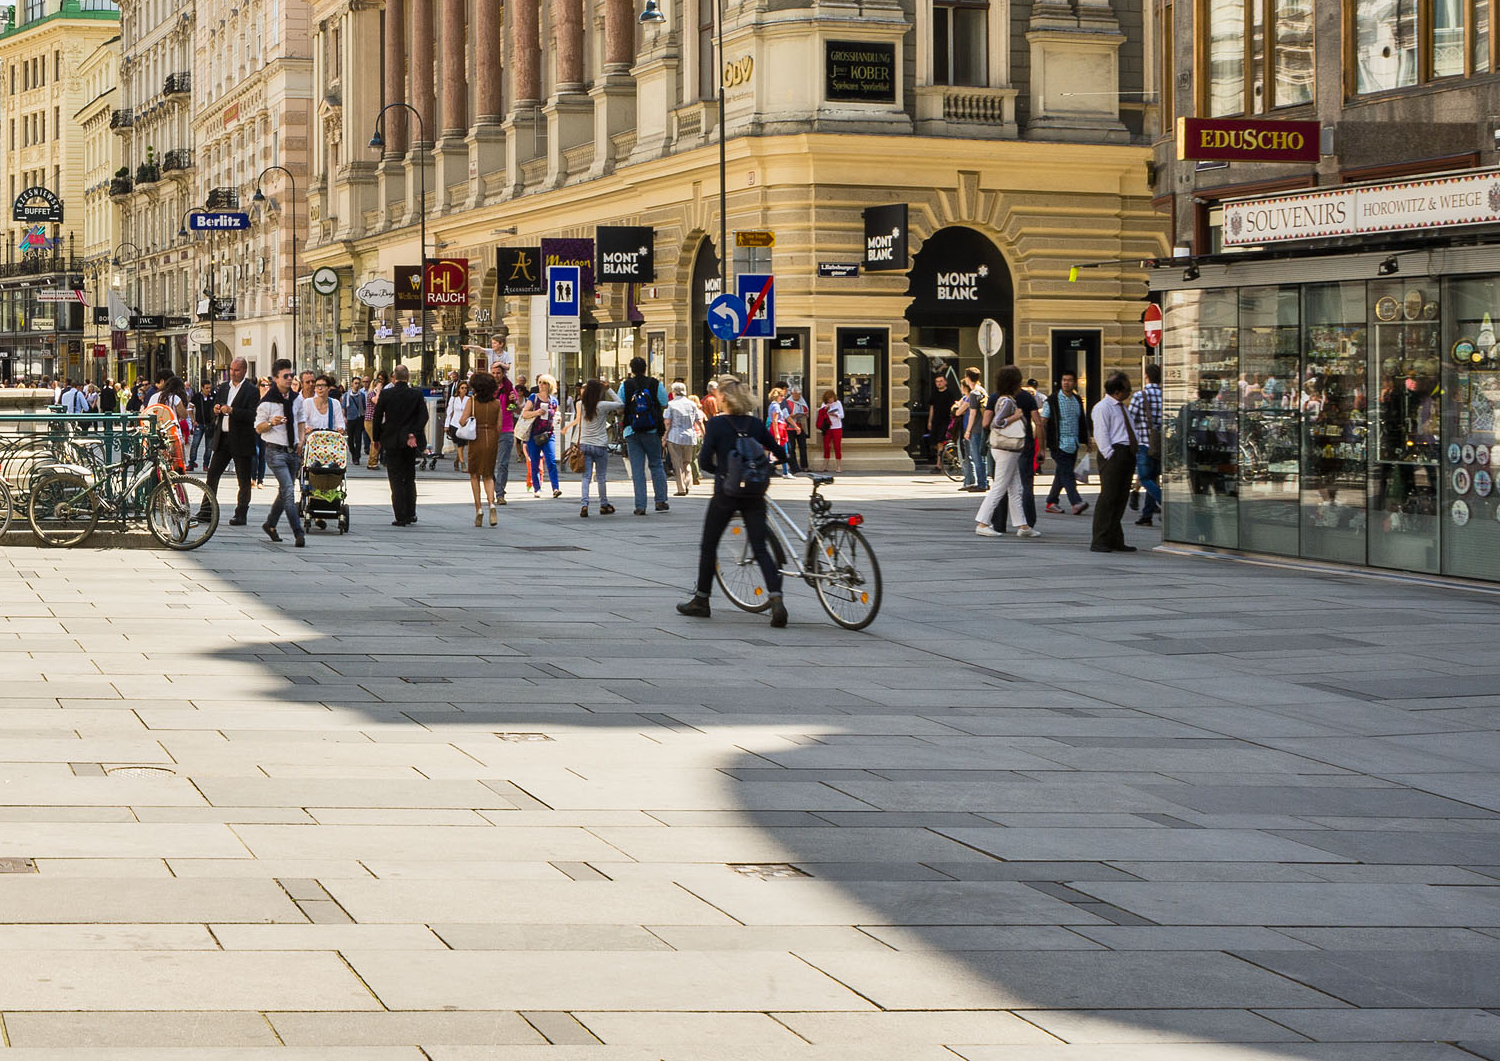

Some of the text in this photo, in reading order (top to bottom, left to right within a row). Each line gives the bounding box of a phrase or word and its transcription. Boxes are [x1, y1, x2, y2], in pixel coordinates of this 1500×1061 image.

[851, 66, 890, 80] KOBER
[1200, 129, 1305, 150] EDUSCHO
[1246, 191, 1483, 233] SOUVENIRS HOROWITZ & WEEGE
[196, 215, 241, 227] Berlitz
[868, 235, 893, 249] MONT
[546, 254, 591, 268] Monsoon
[603, 252, 638, 263] MONT
[868, 248, 893, 261] BLANC
[603, 263, 639, 274] BLANC
[937, 272, 978, 286] MONT
[427, 293, 466, 303] RAUCH
[937, 287, 978, 300] BLANC
